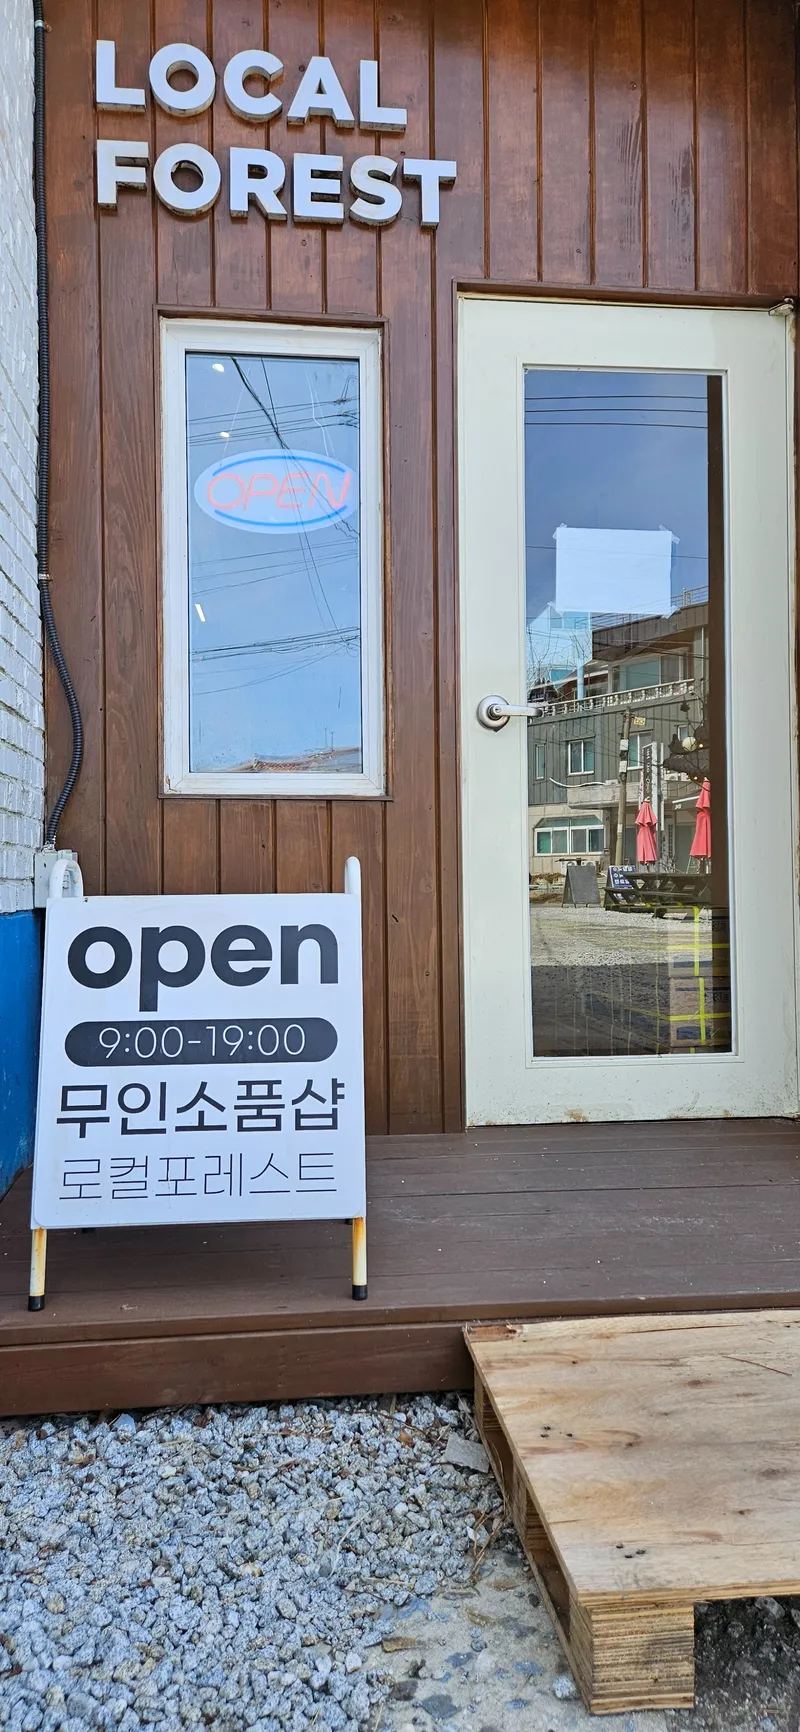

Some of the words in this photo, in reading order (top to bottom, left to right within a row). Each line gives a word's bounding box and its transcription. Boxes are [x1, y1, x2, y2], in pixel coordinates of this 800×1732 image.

[96, 40, 408, 131] LOCAL
[96, 140, 457, 227] FOREST
[207, 472, 351, 511] OPEN
[68, 924, 338, 1012] open
[99, 1024, 306, 1059] 9:00-19:00
[57, 1078, 344, 1138] 무인소품샵
[59, 1152, 337, 1199] 로컬포레스트
